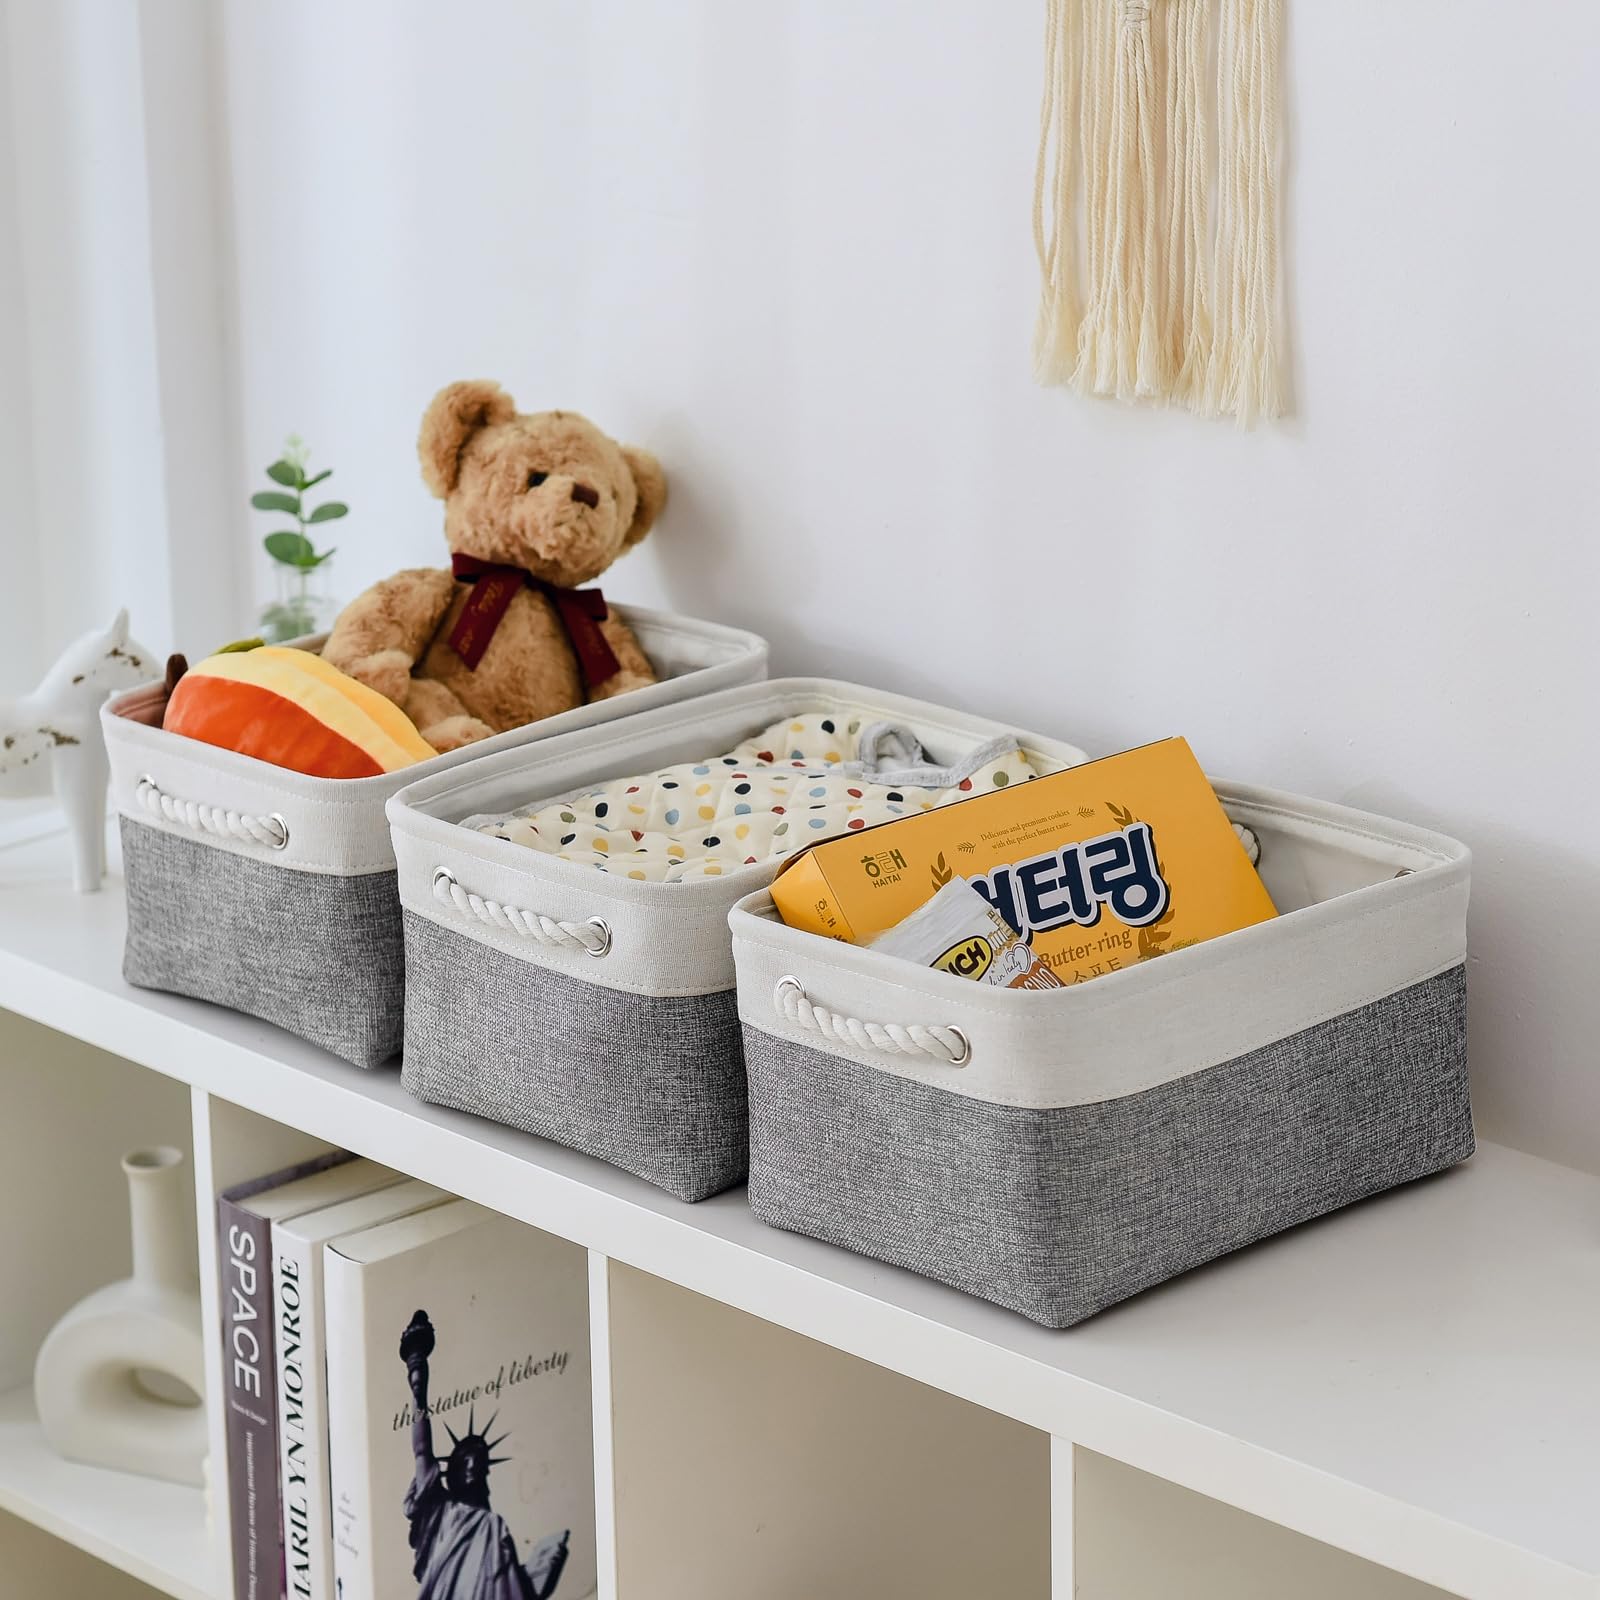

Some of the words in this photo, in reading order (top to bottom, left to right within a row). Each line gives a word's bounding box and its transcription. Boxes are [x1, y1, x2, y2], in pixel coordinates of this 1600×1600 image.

[980, 829, 1009, 841] Delicious
[1009, 824, 1021, 834] and
[1021, 817, 1048, 831] premium
[1048, 810, 1070, 821] cookies
[992, 840, 1006, 850] with
[1006, 837, 1016, 847] the
[1016, 831, 1037, 844] perfect
[1036, 826, 1055, 837] butter
[872, 874, 902, 888] HAITAI
[940, 940, 987, 977] ICH
[1040, 929, 1133, 969] Butter-ring
[229, 1225, 261, 1398] SPACE
[279, 1256, 304, 1431] MONROE
[393, 1403, 423, 1431] the
[427, 1389, 481, 1416] statue
[484, 1366, 504, 1399] of
[509, 1352, 569, 1385] liberty
